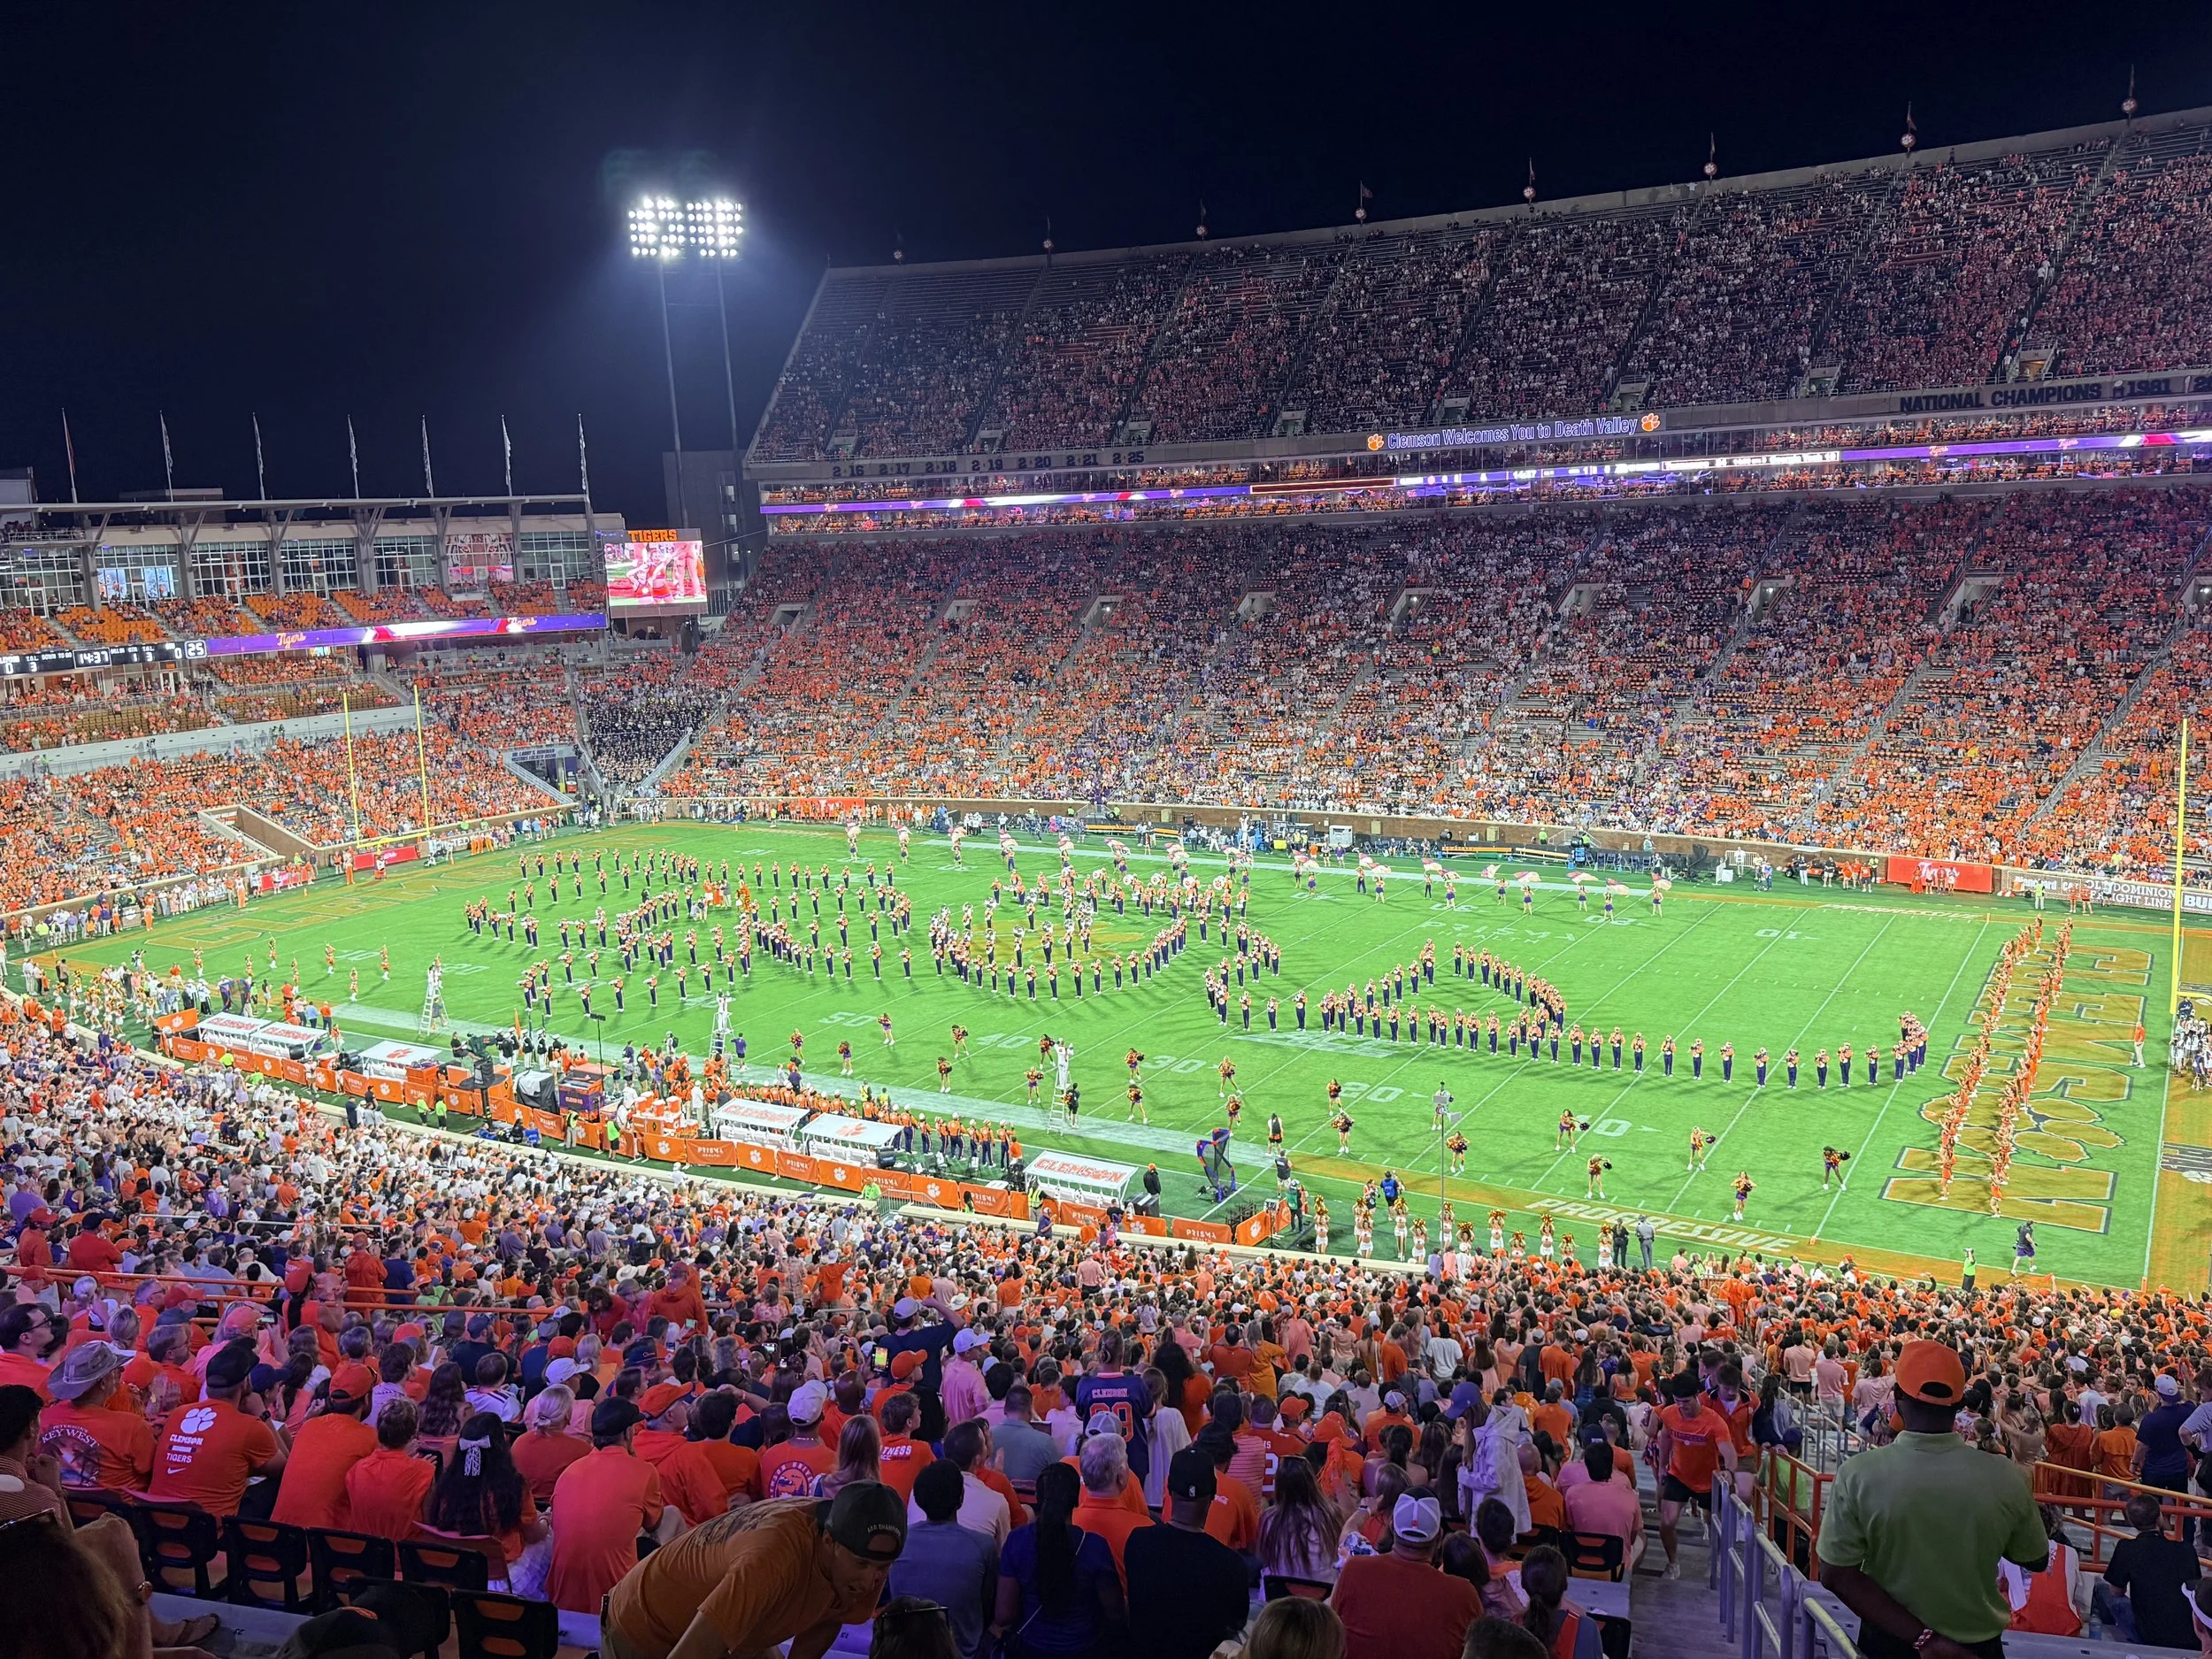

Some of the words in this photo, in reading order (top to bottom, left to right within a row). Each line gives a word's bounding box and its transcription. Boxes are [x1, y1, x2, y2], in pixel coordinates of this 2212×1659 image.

[2127, 377, 2170, 395] 1981
[1901, 395, 1985, 411] NATIONAL
[1991, 382, 2102, 406] CHAMPIONS
[1387, 433, 1440, 449] Clemson
[1442, 424, 1509, 444] Welcomes
[1510, 424, 1534, 441] You
[1537, 422, 1551, 438] to
[1555, 419, 1594, 437] Death
[1595, 417, 1638, 435] Valley
[628, 529, 678, 542] TIGERS
[276, 632, 307, 649] Tigers
[146, 651, 153, 662] 3
[174, 647, 182, 660] 0
[188, 642, 204, 657] 25
[79, 651, 109, 664] 14:37
[5, 663, 14, 674] 0
[30, 662, 37, 672] 3
[2113, 881, 2176, 898] DOMINION
[2145, 895, 2171, 908] LINE
[818, 1011, 877, 1027] 50
[979, 1033, 1033, 1049] 40
[1147, 1055, 1207, 1073] 30
[1340, 1081, 1404, 1102] 20
[787, 1159, 810, 1171] PRISMA
[873, 1177, 898, 1187] PRISMA
[1525, 1197, 1798, 1252] PROGRESSIVE
[1186, 1228, 1217, 1240] PRISMA
[42, 1429, 62, 1444] KEY
[66, 1429, 100, 1448] WEST
[169, 1433, 204, 1445] CLEMSON
[166, 1453, 192, 1463] TIGERS
